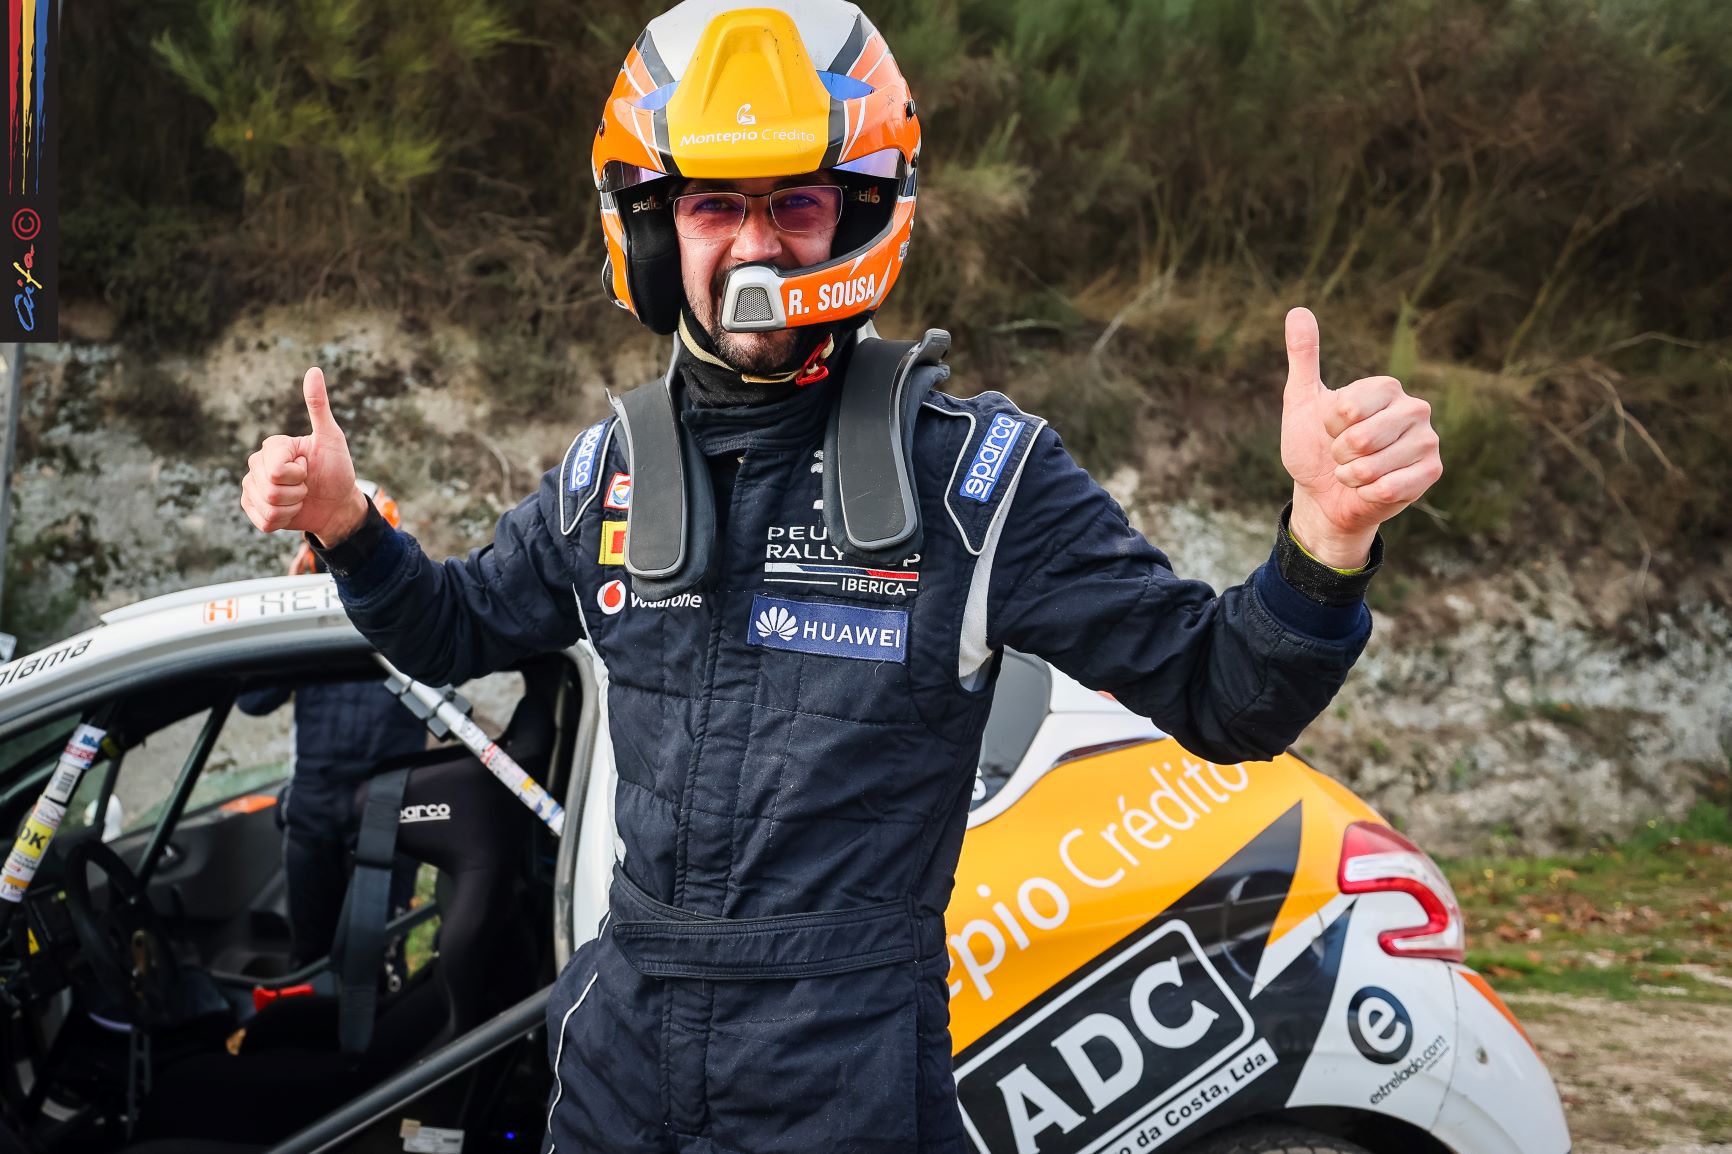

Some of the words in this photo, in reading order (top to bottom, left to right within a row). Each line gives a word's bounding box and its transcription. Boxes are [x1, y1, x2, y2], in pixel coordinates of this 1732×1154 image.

[680, 128, 758, 147] Montepio
[761, 127, 816, 142] Crédito
[788, 289, 810, 316] R.
[818, 273, 875, 310] SOUSA
[574, 424, 604, 486] sparco
[965, 416, 1016, 495] sparco
[766, 544, 844, 561] RALLY
[841, 577, 907, 596] IBERICA
[803, 620, 900, 648] HUAWEI
[1059, 757, 1248, 888] Crédito
[996, 956, 1219, 1154] ADC
[1136, 1127, 1163, 1148] da
[1164, 1084, 1230, 1127] Costa,
[1229, 1052, 1268, 1082] Lda
